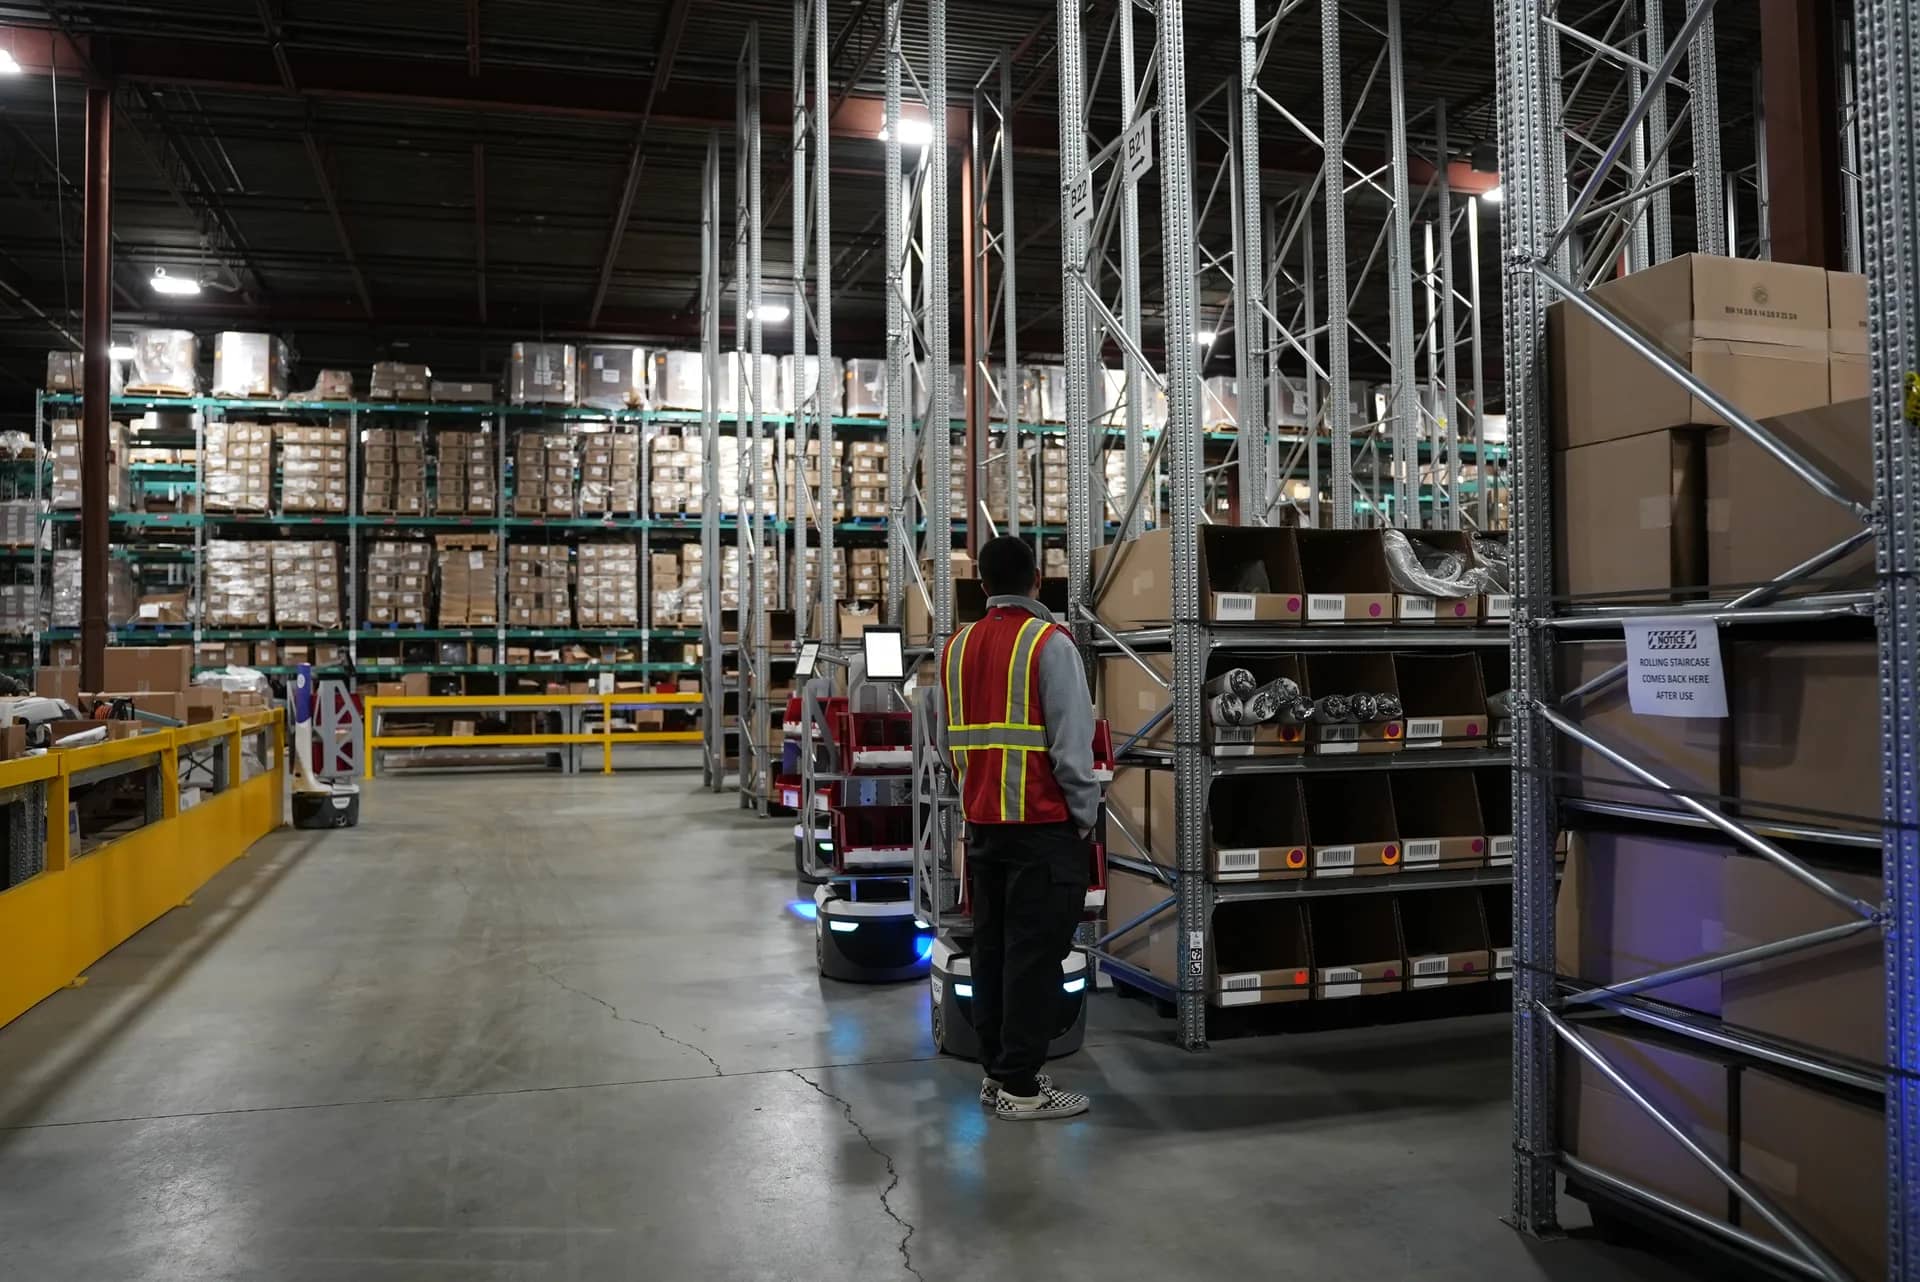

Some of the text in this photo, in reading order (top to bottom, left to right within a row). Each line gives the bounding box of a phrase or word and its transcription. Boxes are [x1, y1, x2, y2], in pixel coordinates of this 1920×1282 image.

[1128, 126, 1146, 160] B21
[1072, 179, 1087, 208] B22
[1657, 635, 1686, 645] NOTICE
[1639, 657, 1711, 667] ROLLING STAIRCASE
[1642, 674, 1710, 684] COMES BACK HERE
[1656, 691, 1695, 701] AFTER USE
